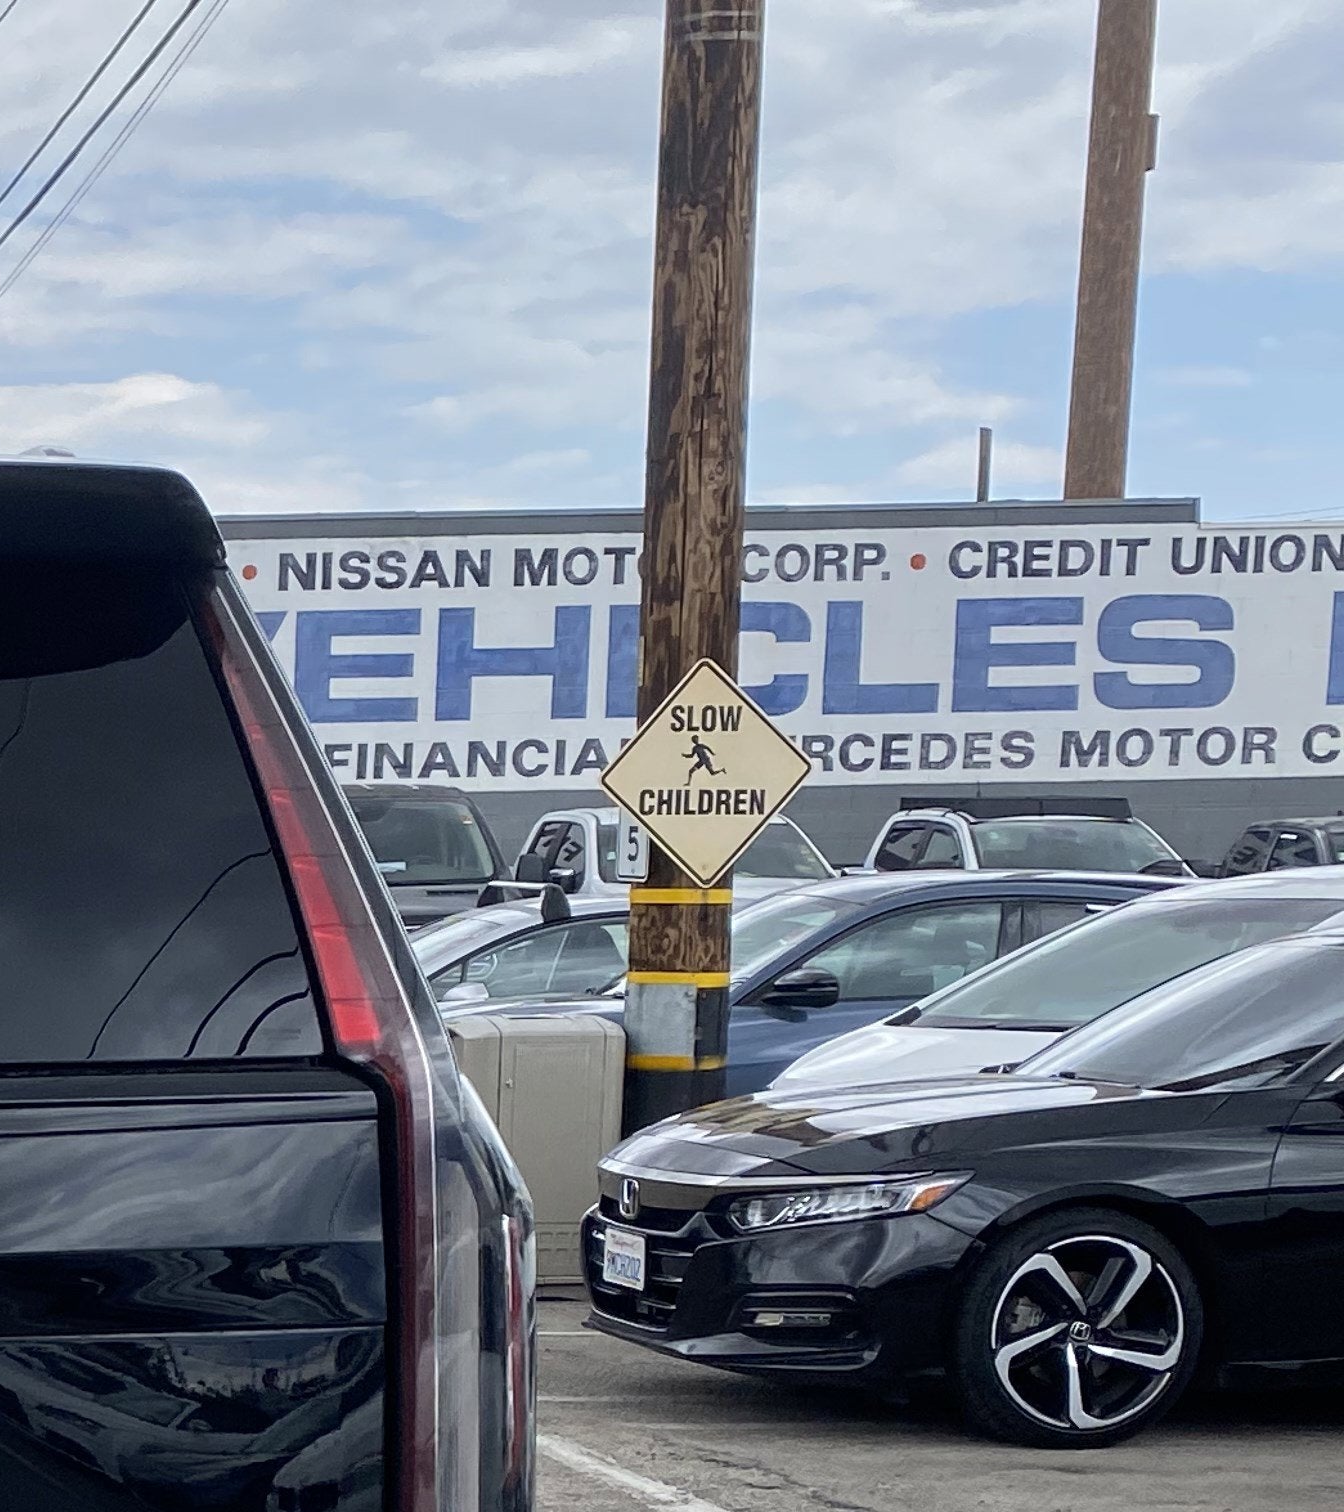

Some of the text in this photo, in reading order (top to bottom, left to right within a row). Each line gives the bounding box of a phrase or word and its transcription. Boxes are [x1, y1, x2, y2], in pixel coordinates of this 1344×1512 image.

[278, 533, 1344, 591] NISSAN MOT CORP. CREDIT UNION
[255, 593, 1236, 723] EHILES
[670, 704, 743, 732] SLOW
[324, 737, 631, 780] FINANCIA
[789, 729, 1036, 773] RCEDES
[1060, 726, 1279, 768] MOTOR
[639, 789, 766, 816] CHILDREN
[627, 825, 640, 862] 5
